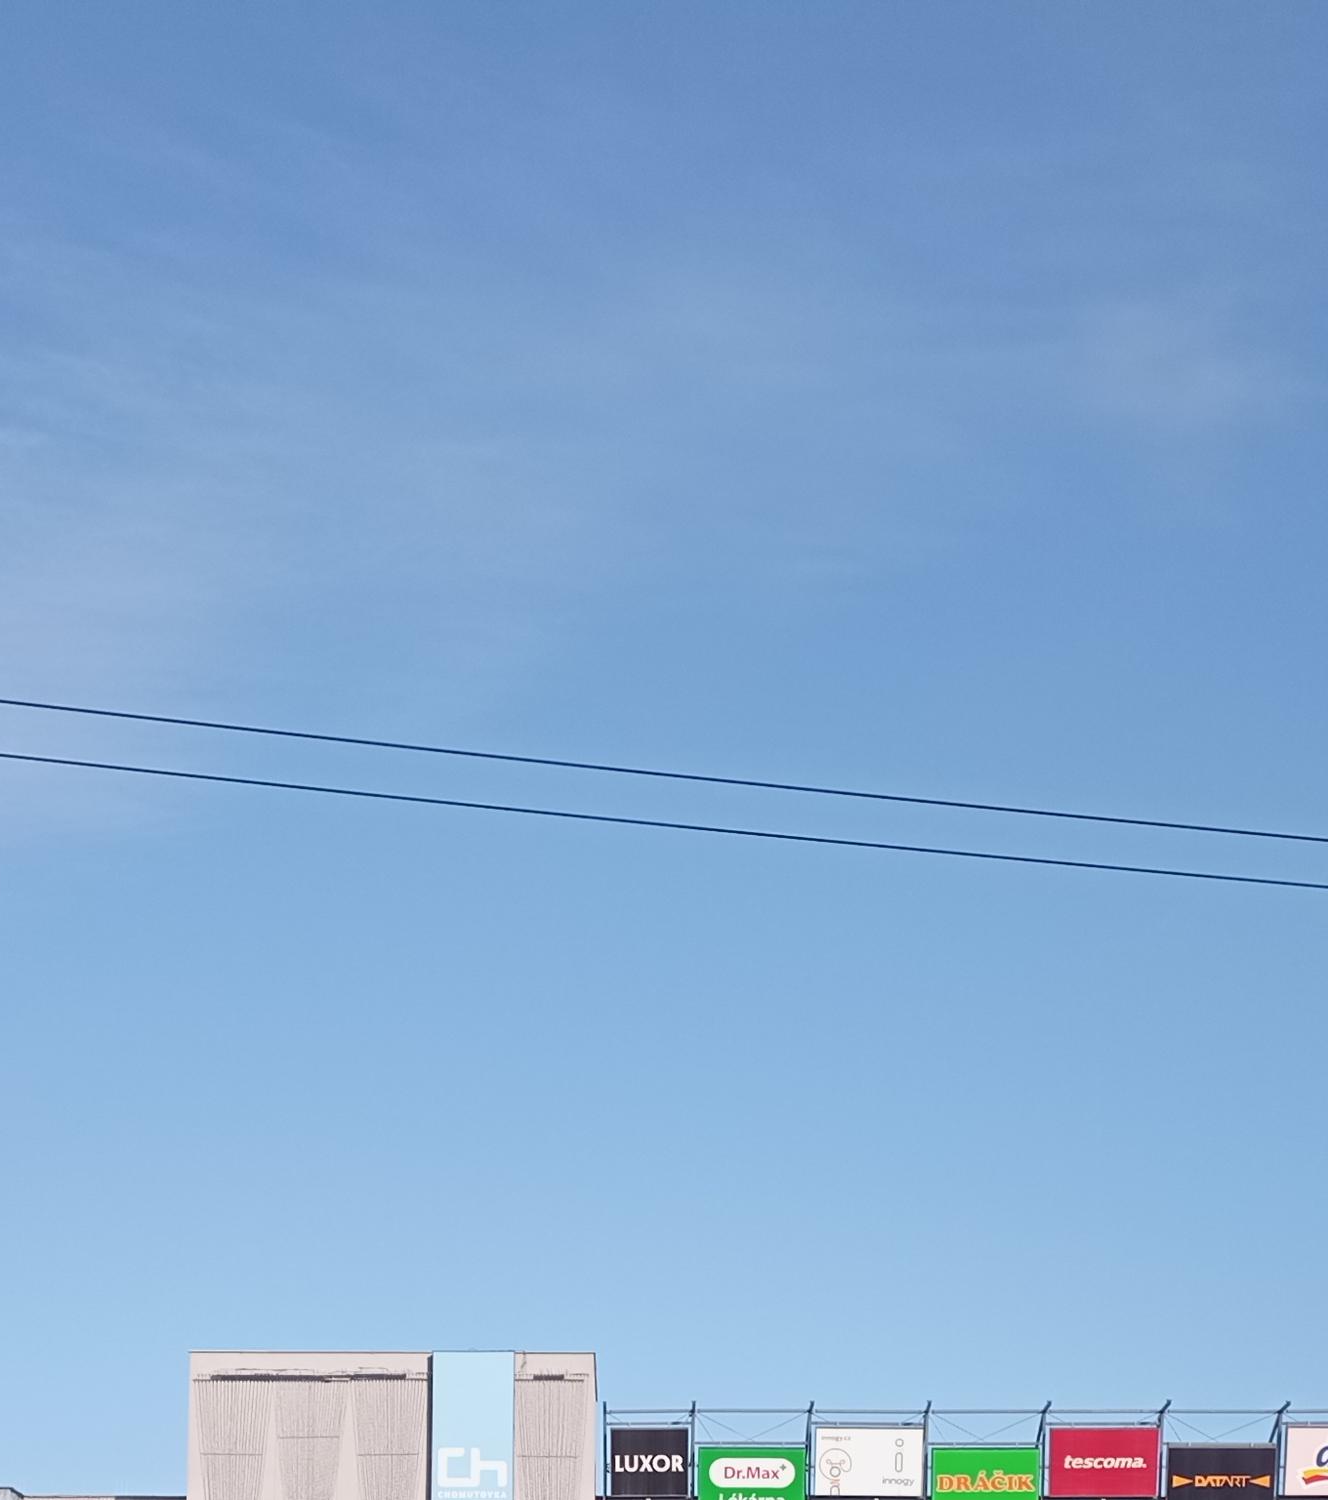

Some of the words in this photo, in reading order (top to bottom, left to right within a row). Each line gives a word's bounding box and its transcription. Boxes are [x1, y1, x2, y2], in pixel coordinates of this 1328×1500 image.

[614, 1454, 685, 1473] LUXOR
[882, 1476, 915, 1487] innogy
[936, 1470, 1036, 1492] DRÁČIK
[1194, 1475, 1251, 1488] DATART
